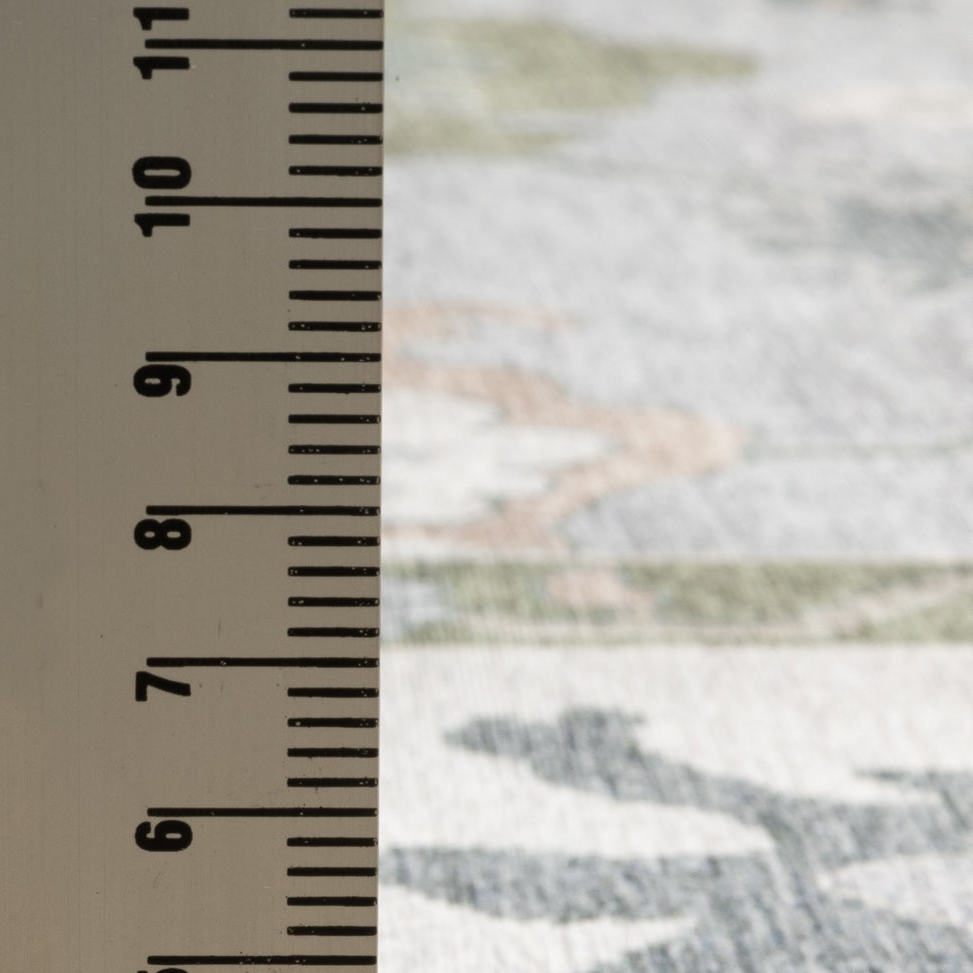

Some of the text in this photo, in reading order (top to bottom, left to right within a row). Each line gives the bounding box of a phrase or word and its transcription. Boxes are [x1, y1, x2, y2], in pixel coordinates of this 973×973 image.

[133, 7, 190, 80] 11
[132, 156, 191, 238] 10
[133, 364, 192, 398] 9
[133, 518, 192, 551] 8
[135, 671, 192, 702] 7
[134, 819, 193, 852] 6
